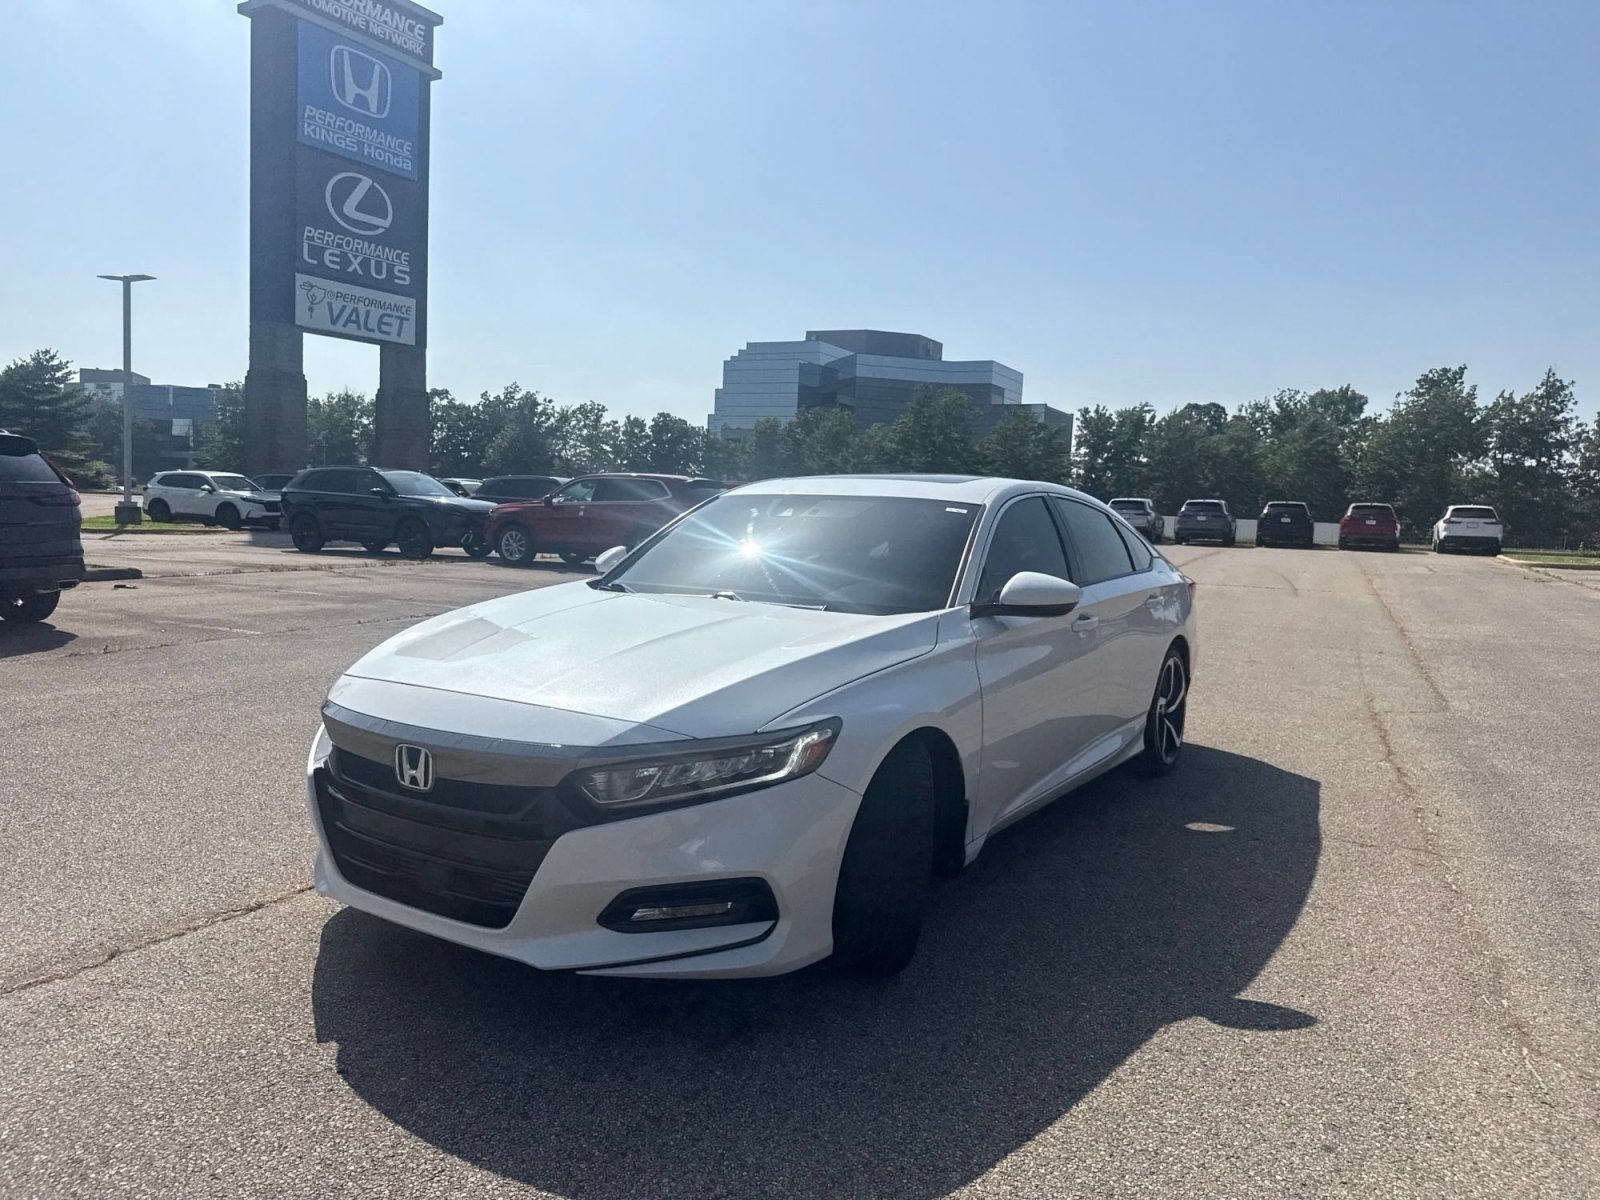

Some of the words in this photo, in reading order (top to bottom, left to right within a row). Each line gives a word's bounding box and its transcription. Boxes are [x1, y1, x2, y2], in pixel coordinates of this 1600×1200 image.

[305, 0, 366, 29] OMOTIVE
[369, 22, 424, 55] NETWORK
[342, 0, 425, 41] RMANCE
[304, 105, 412, 154] PERFORMANCE
[304, 124, 358, 152] KINGS
[364, 144, 412, 170] Honda
[303, 243, 410, 285] LEXUS
[304, 226, 410, 265] PERFORMANCE
[327, 301, 409, 337] VALET
[335, 291, 412, 316] PERFORMANCE
